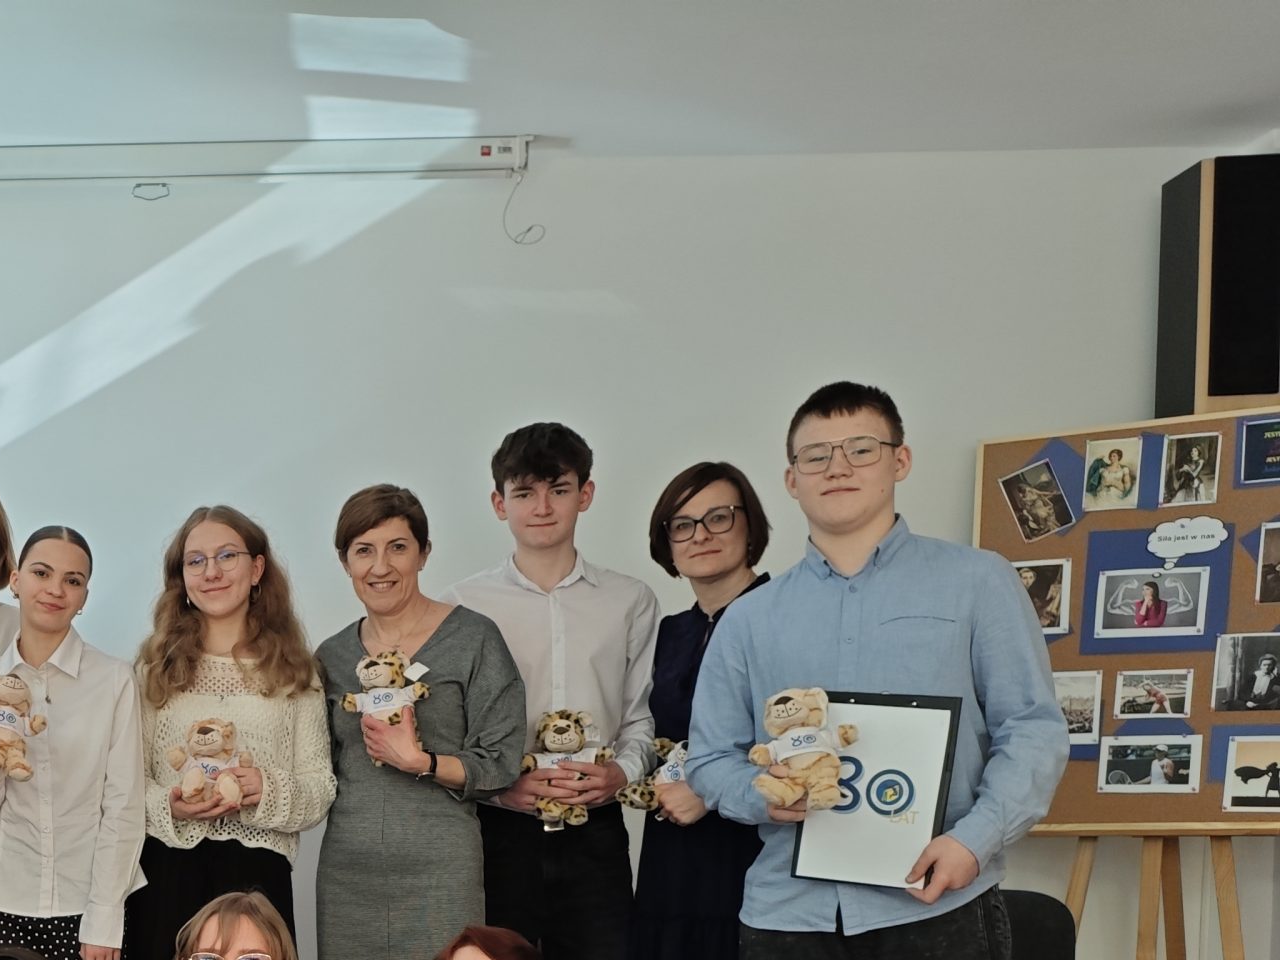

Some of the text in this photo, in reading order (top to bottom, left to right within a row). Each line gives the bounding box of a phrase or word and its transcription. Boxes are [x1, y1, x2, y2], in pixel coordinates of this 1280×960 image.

[1173, 534, 1189, 543] jest
[373, 692, 393, 704] 80
[791, 734, 817, 747] 80
[831, 755, 915, 816] 80
[889, 809, 920, 825] LAT
